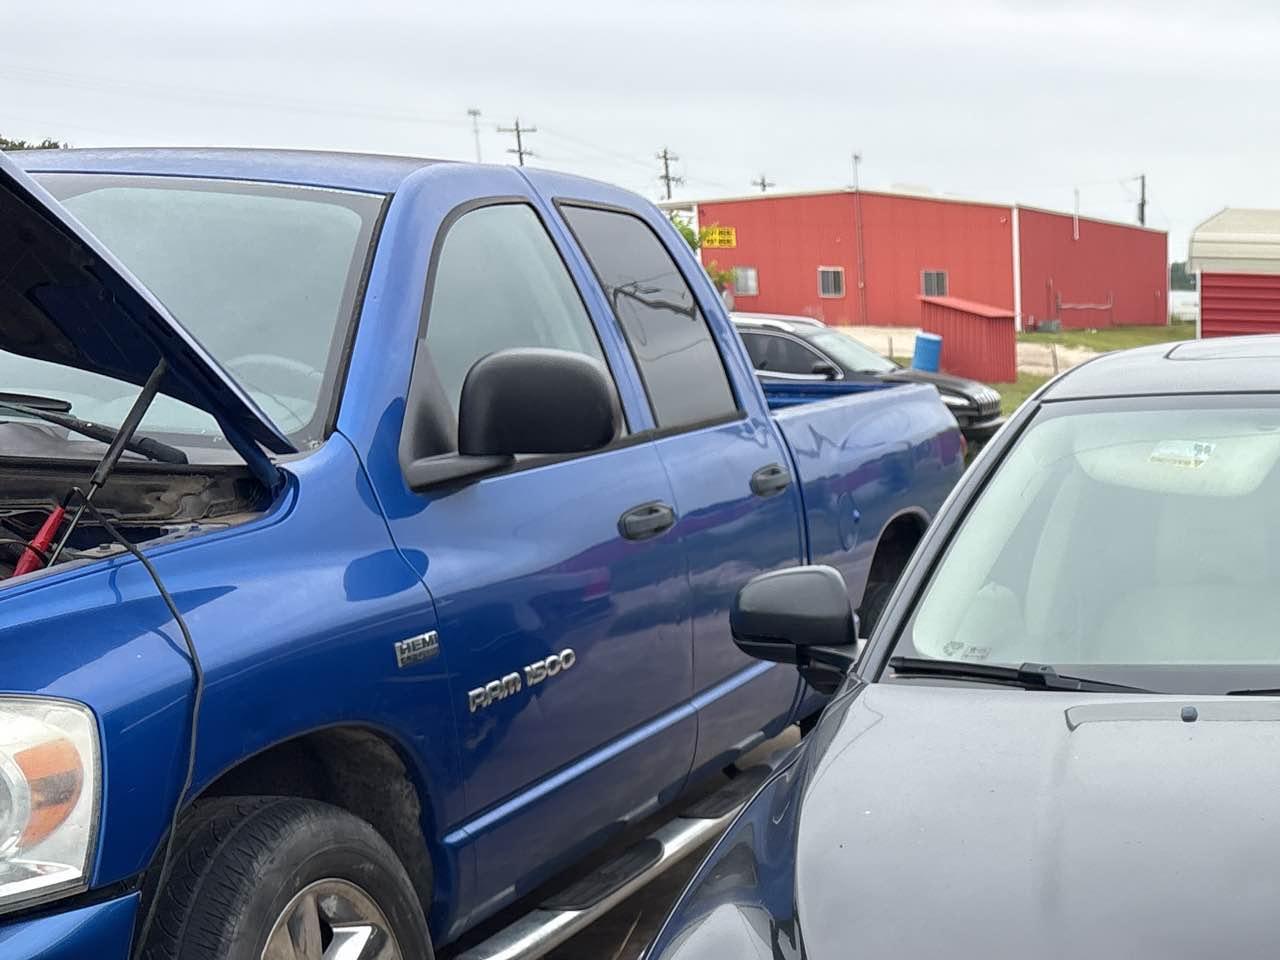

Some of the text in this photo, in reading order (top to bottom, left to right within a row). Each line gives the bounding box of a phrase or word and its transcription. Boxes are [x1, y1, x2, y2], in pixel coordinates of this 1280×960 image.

[399, 632, 438, 655] HEMI
[468, 648, 576, 713] RAM 1500
